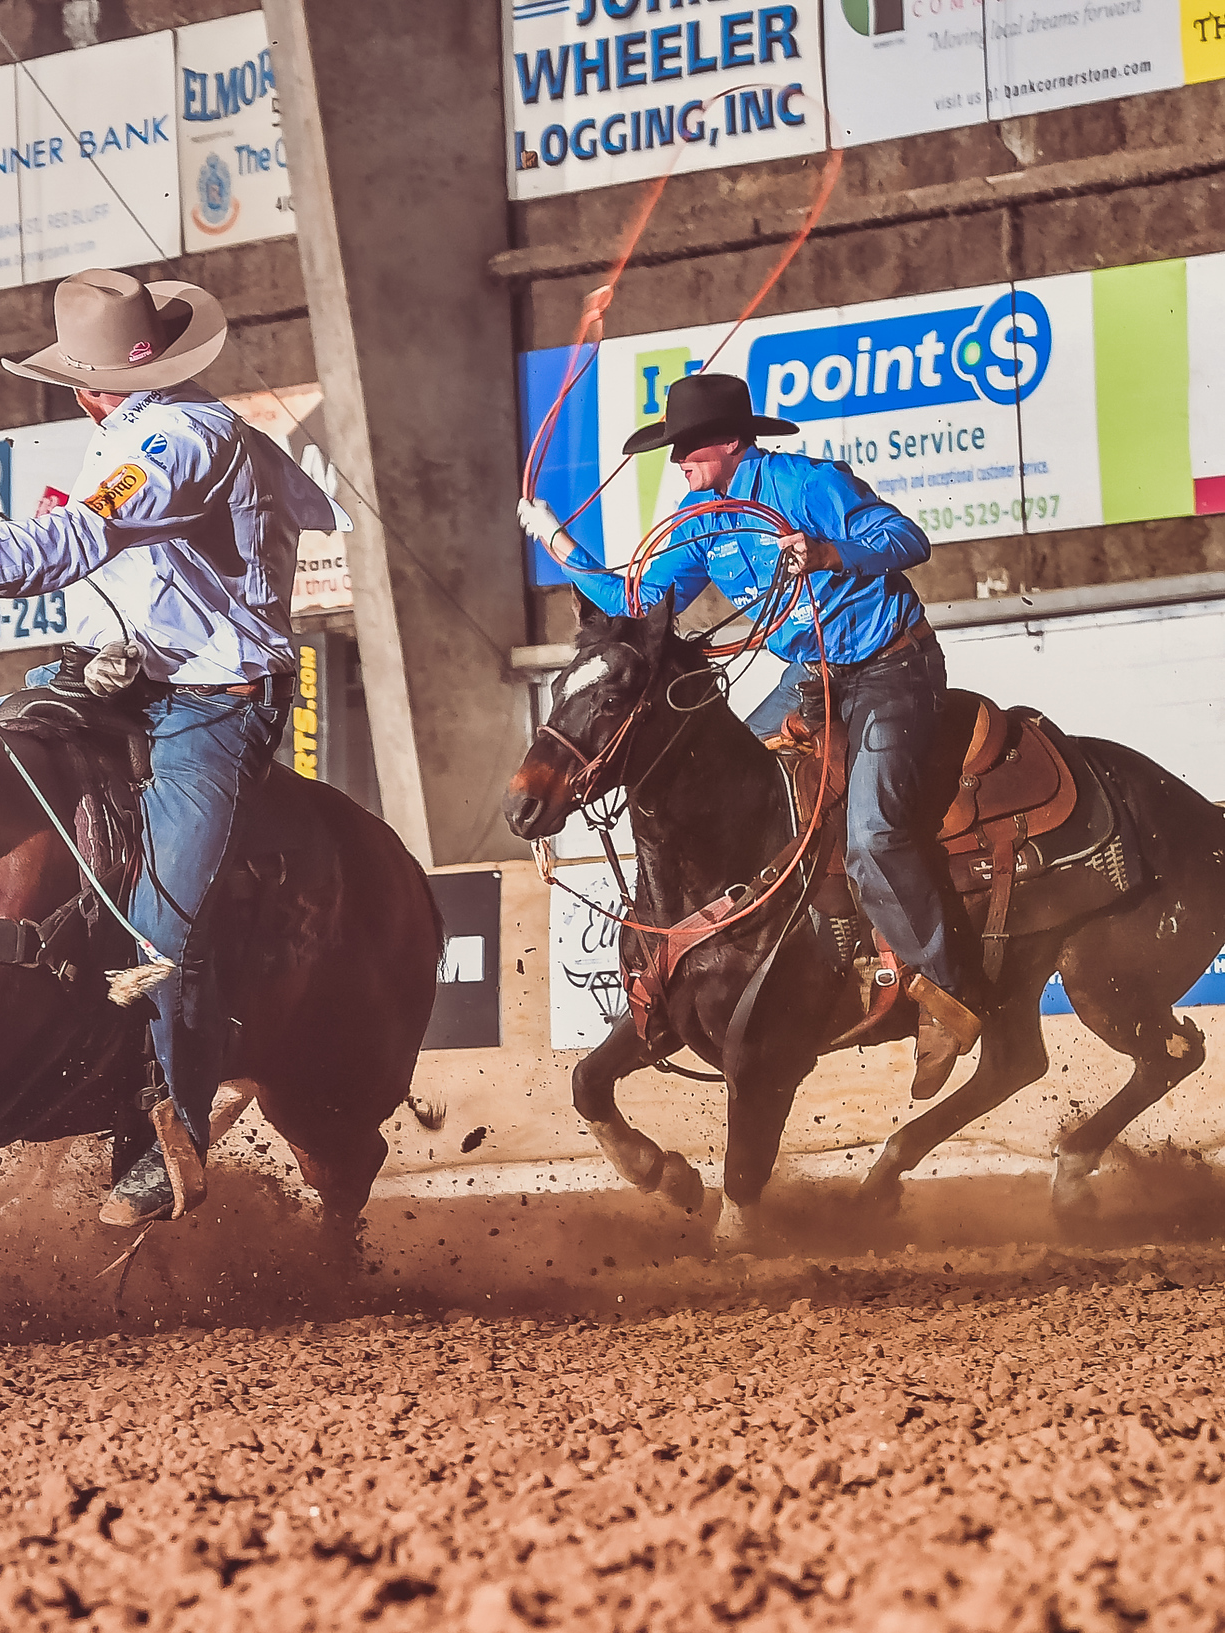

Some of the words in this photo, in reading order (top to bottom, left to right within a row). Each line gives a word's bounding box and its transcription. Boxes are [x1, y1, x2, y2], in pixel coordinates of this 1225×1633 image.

[1027, 11, 1079, 33] dreams
[514, 4, 801, 105] WHEELER
[934, 93, 962, 111] visit
[967, 91, 982, 106] us
[1004, 59, 1152, 99] bankcornerstone.com
[78, 114, 170, 159] BANK
[234, 144, 271, 177] The
[764, 330, 946, 419] point
[822, 436, 879, 467] Auto
[887, 422, 986, 460] Service
[918, 494, 1061, 533] 530-529-0797
[297, 556, 349, 573] Ranc
